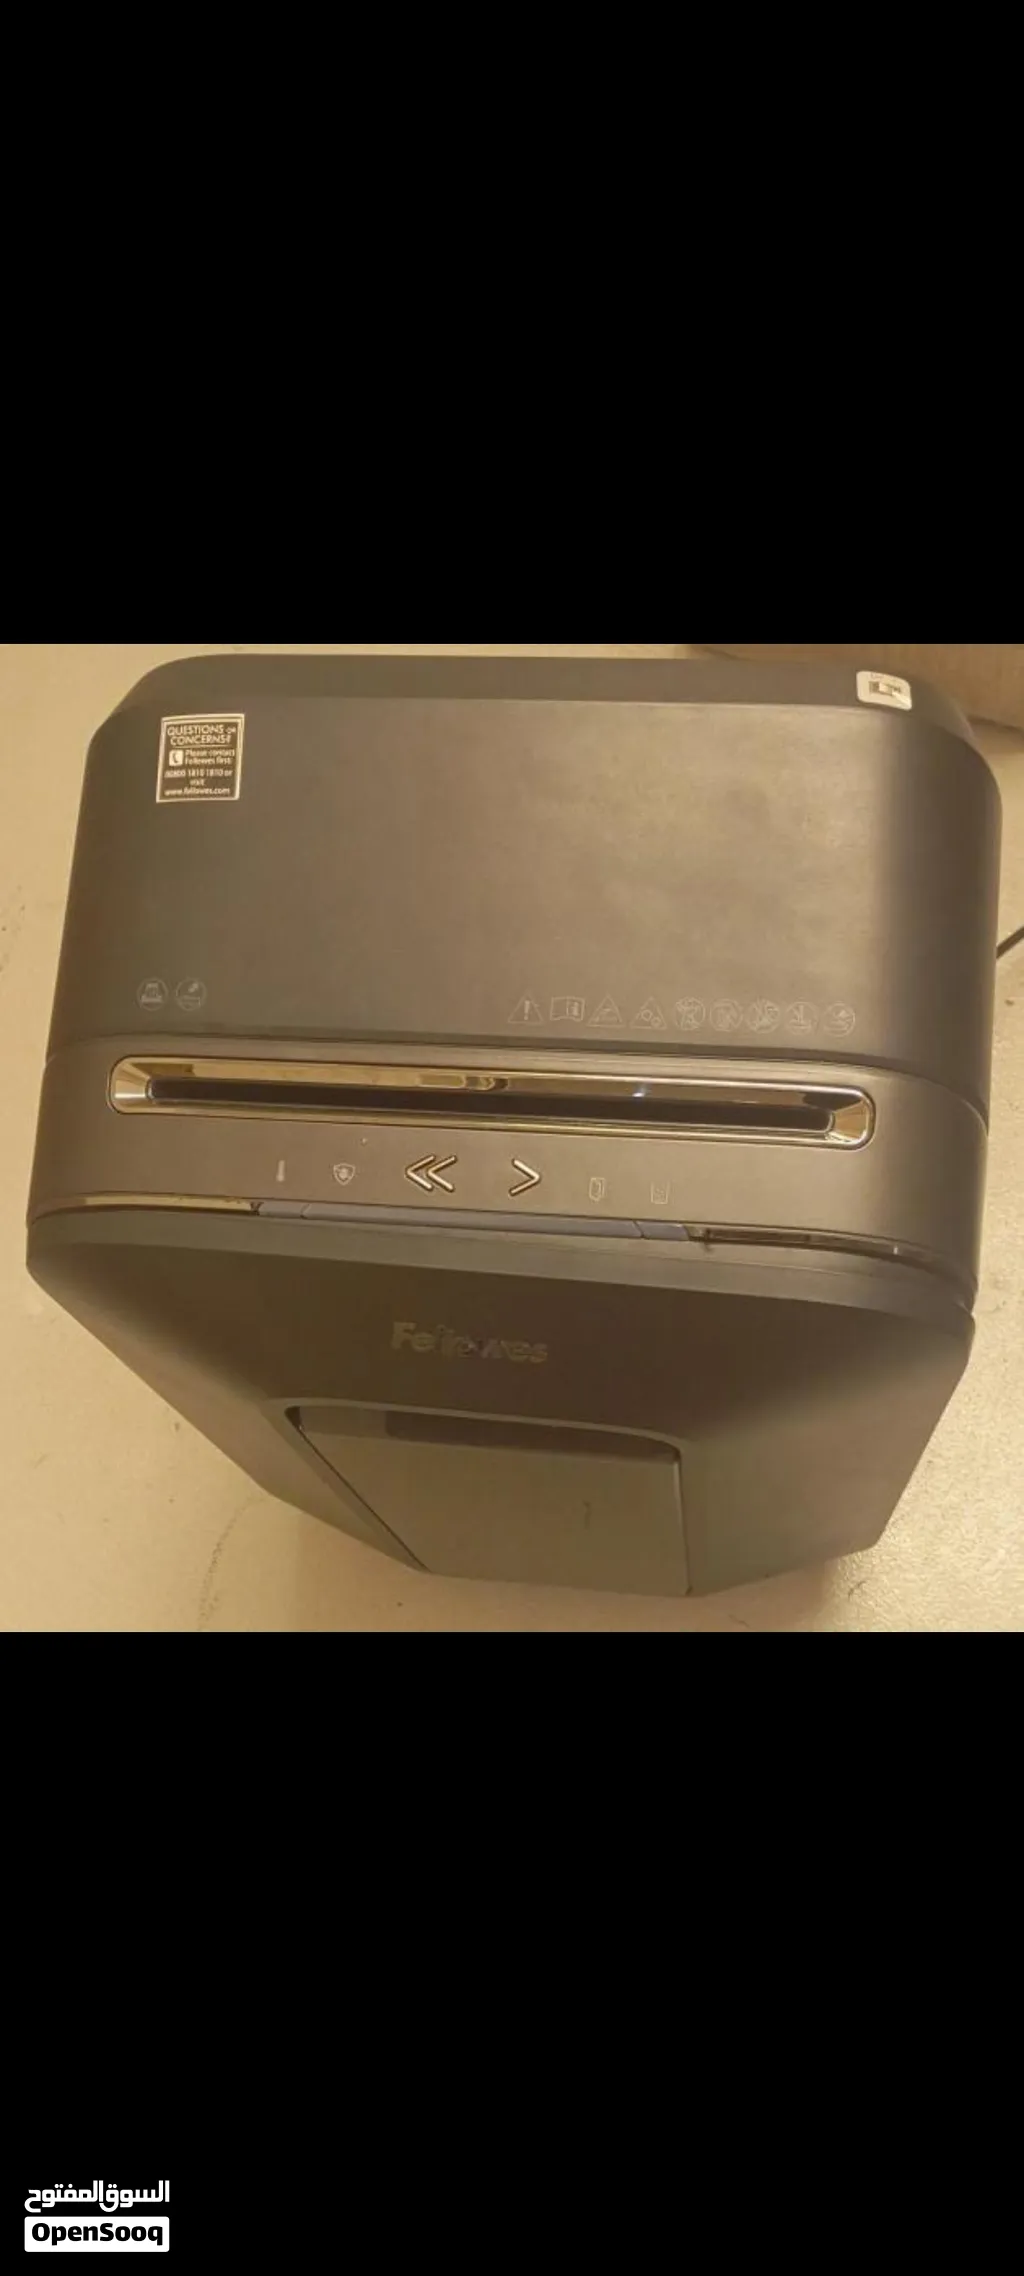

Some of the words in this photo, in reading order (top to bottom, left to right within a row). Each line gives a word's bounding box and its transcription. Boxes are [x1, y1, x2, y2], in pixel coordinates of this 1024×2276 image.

[167, 724, 224, 736] QUESTIONS
[170, 734, 232, 746] CONCERNS?
[208, 749, 235, 757] contact
